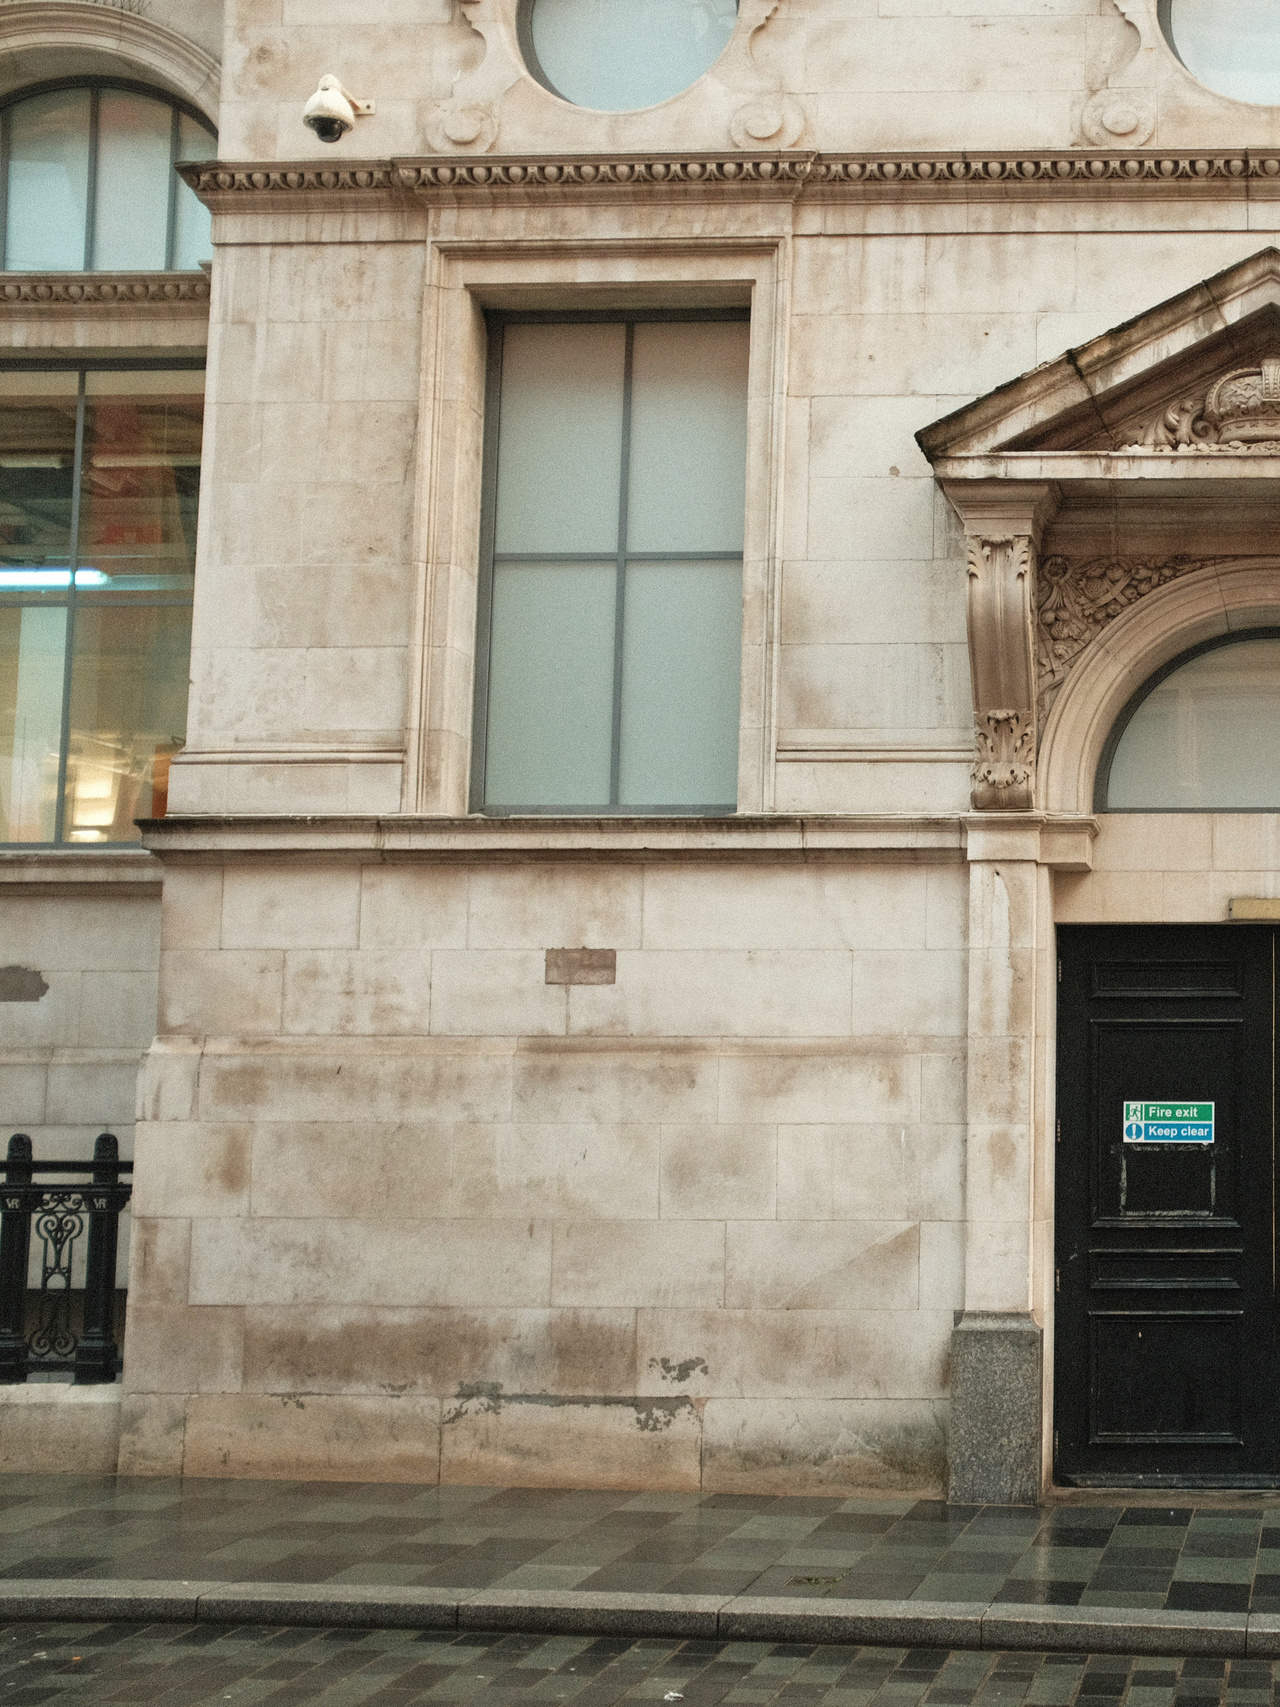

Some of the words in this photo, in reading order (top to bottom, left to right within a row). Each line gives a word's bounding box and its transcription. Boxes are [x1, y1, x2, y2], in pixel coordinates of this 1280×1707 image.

[1149, 1107, 1172, 1117] Fire
[1175, 1107, 1198, 1117] exit
[1149, 1126, 1178, 1138] Keep
[1181, 1126, 1209, 1136] clear
